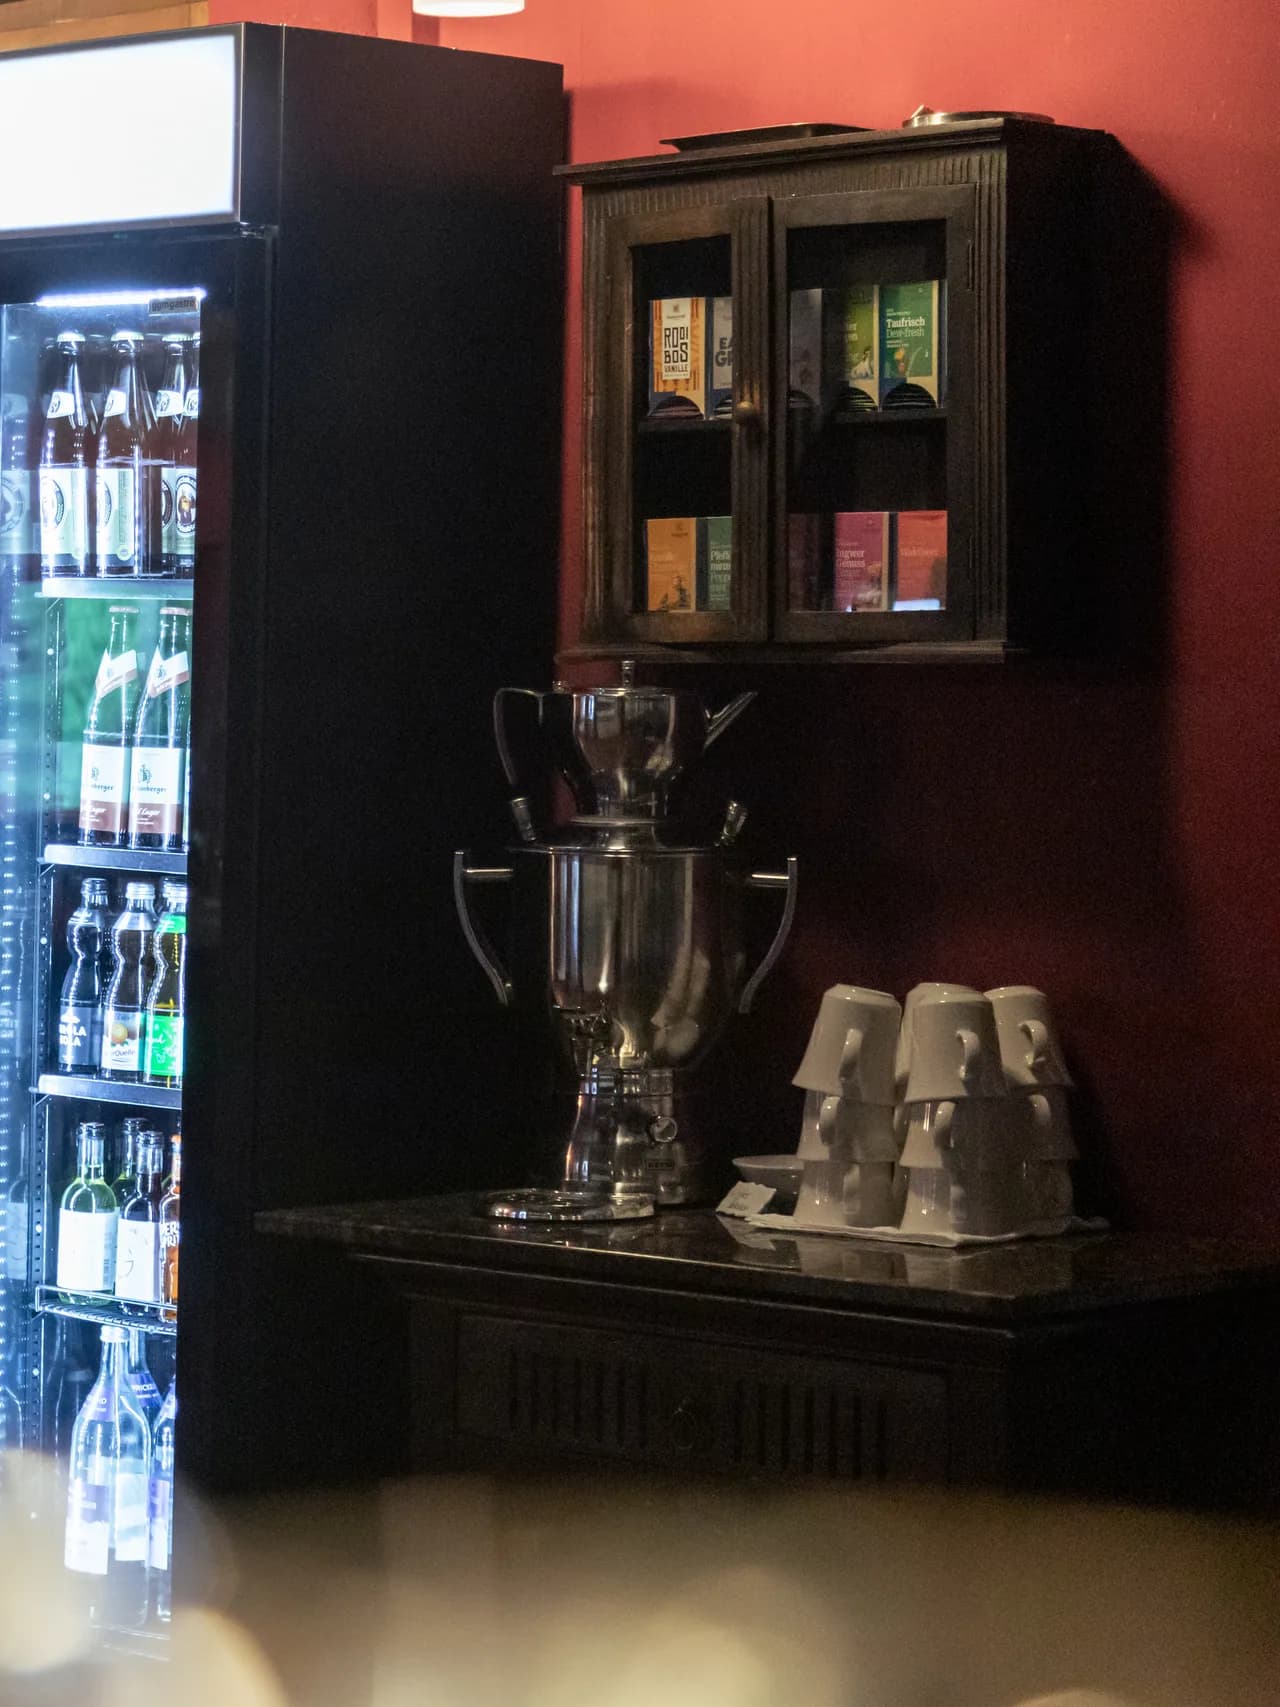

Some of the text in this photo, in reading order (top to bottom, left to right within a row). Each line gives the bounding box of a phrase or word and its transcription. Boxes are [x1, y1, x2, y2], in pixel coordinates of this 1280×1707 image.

[886, 316, 925, 329] Taufrisch
[664, 342, 688, 364] BOS
[664, 363, 688, 373] VANILLE
